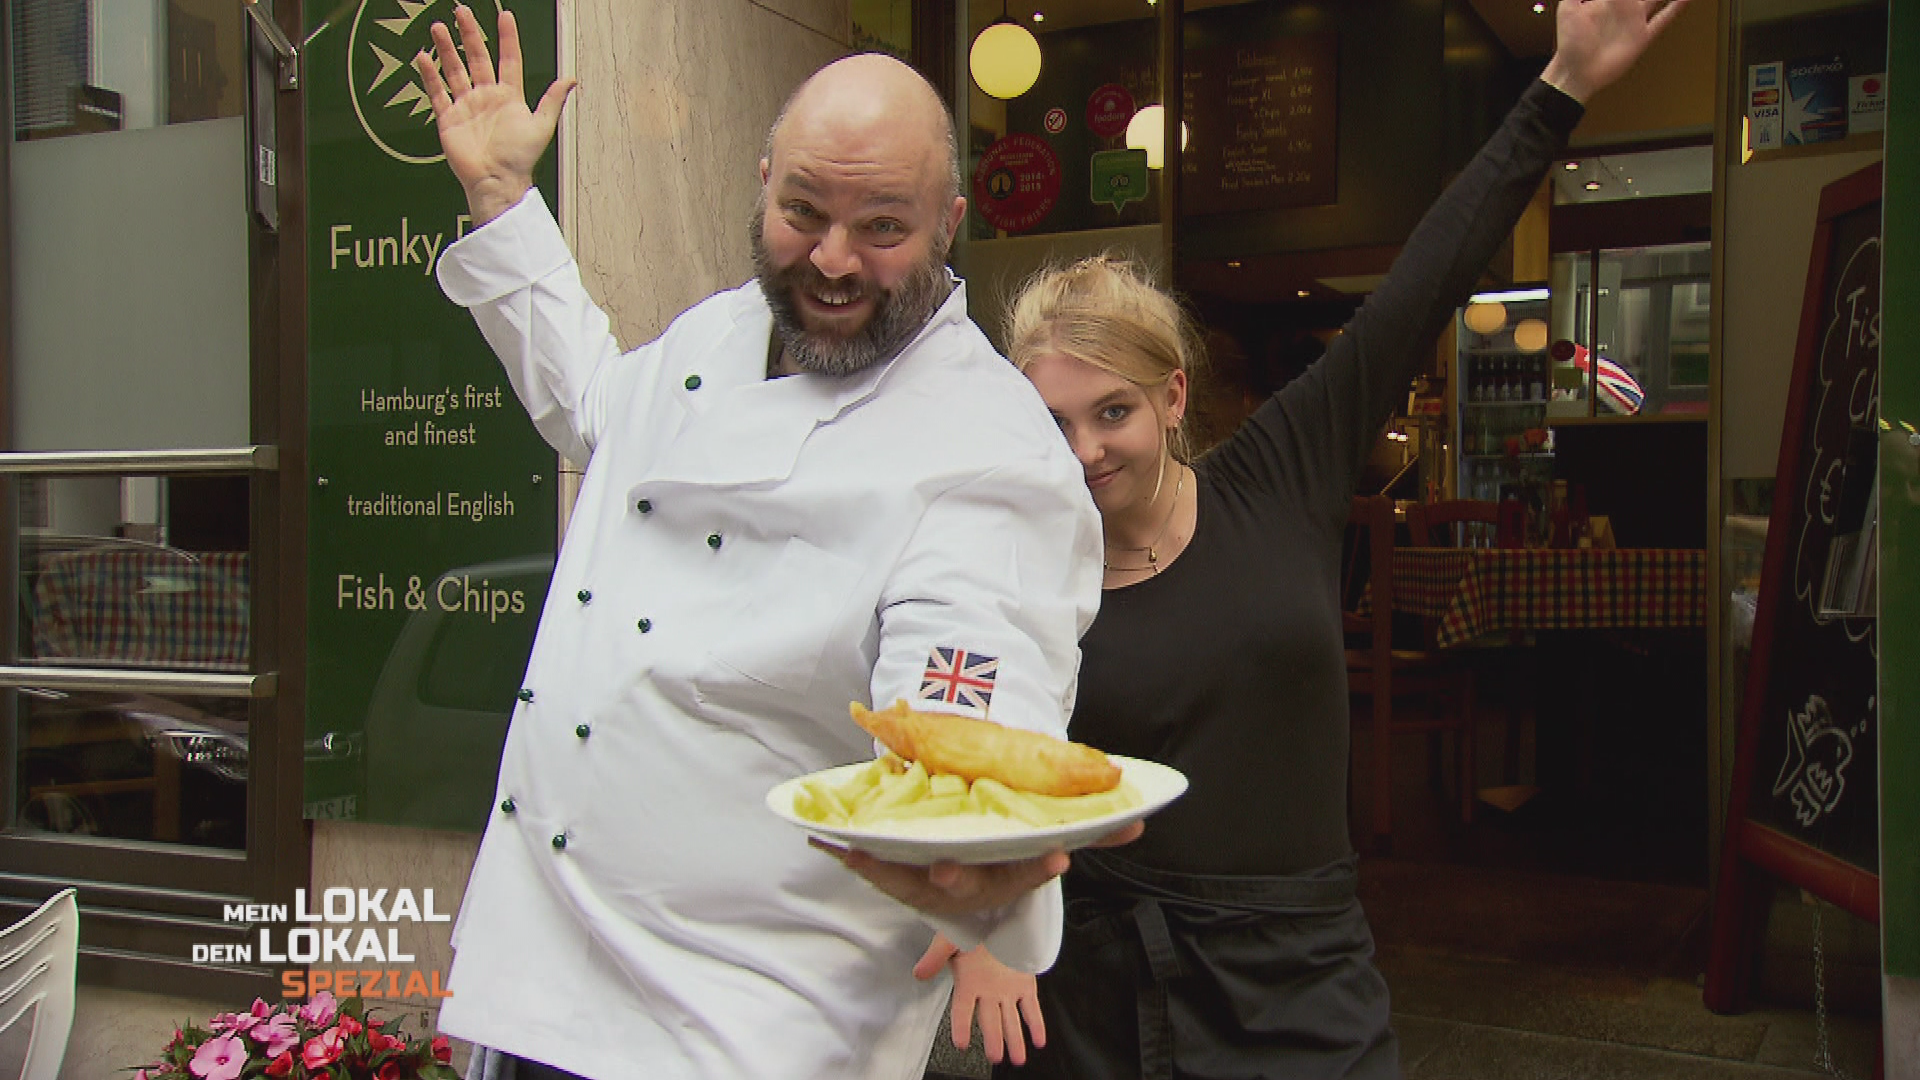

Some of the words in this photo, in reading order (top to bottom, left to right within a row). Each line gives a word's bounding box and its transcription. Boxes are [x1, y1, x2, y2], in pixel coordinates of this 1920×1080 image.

[1790, 62, 1843, 78] sodexo
[1754, 108, 1779, 118] VISA
[331, 217, 443, 276] Funky
[361, 386, 460, 415] Hamburg's
[464, 385, 502, 408] first
[384, 421, 418, 446] and
[424, 421, 476, 446] finest
[348, 491, 441, 516] traditional
[448, 491, 515, 521] English
[337, 573, 395, 610] Fish
[404, 575, 427, 610] &
[436, 575, 526, 623] Chips
